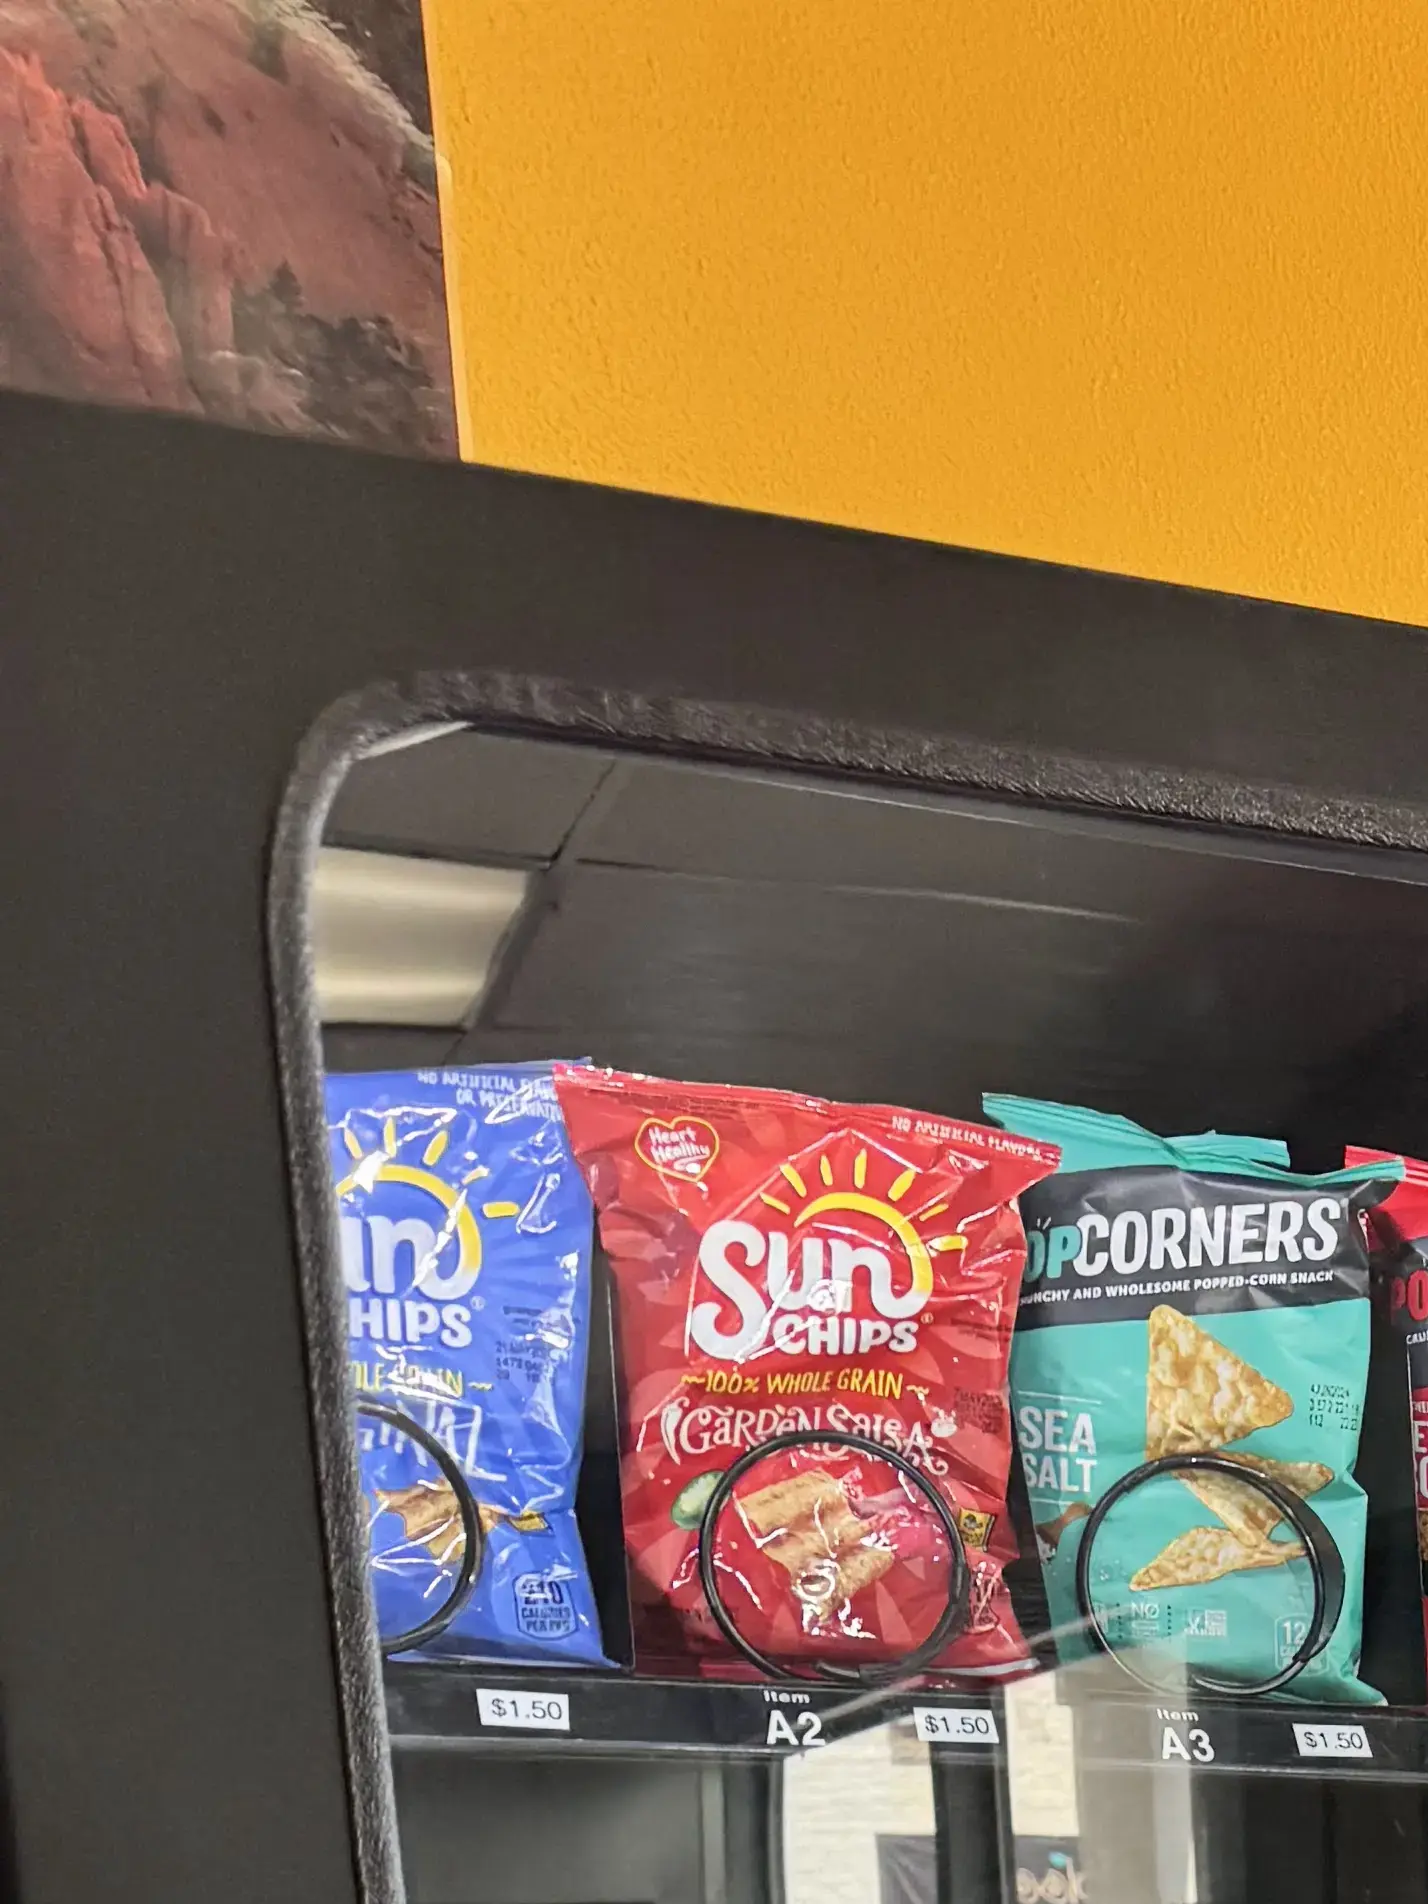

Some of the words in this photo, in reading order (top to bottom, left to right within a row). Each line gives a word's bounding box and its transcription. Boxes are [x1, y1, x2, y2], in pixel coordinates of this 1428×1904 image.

[649, 1126, 697, 1145] Heart
[690, 1218, 933, 1361] Sun
[1073, 1286, 1102, 1300] AND
[1105, 1279, 1191, 1298] WHOLESOME
[771, 1316, 919, 1356] CHIPS
[704, 1369, 760, 1396] 100%
[766, 1371, 832, 1395] WHOLE
[837, 1367, 904, 1399] GRAIN
[1018, 1405, 1097, 1456] SEA
[1025, 1454, 1097, 1493] SALT
[491, 1698, 562, 1721] $1.50
[923, 1713, 990, 1737] $1.50
[766, 1712, 826, 1746] A2
[1161, 1726, 1216, 1763] A3
[1303, 1730, 1365, 1753] $1.50
